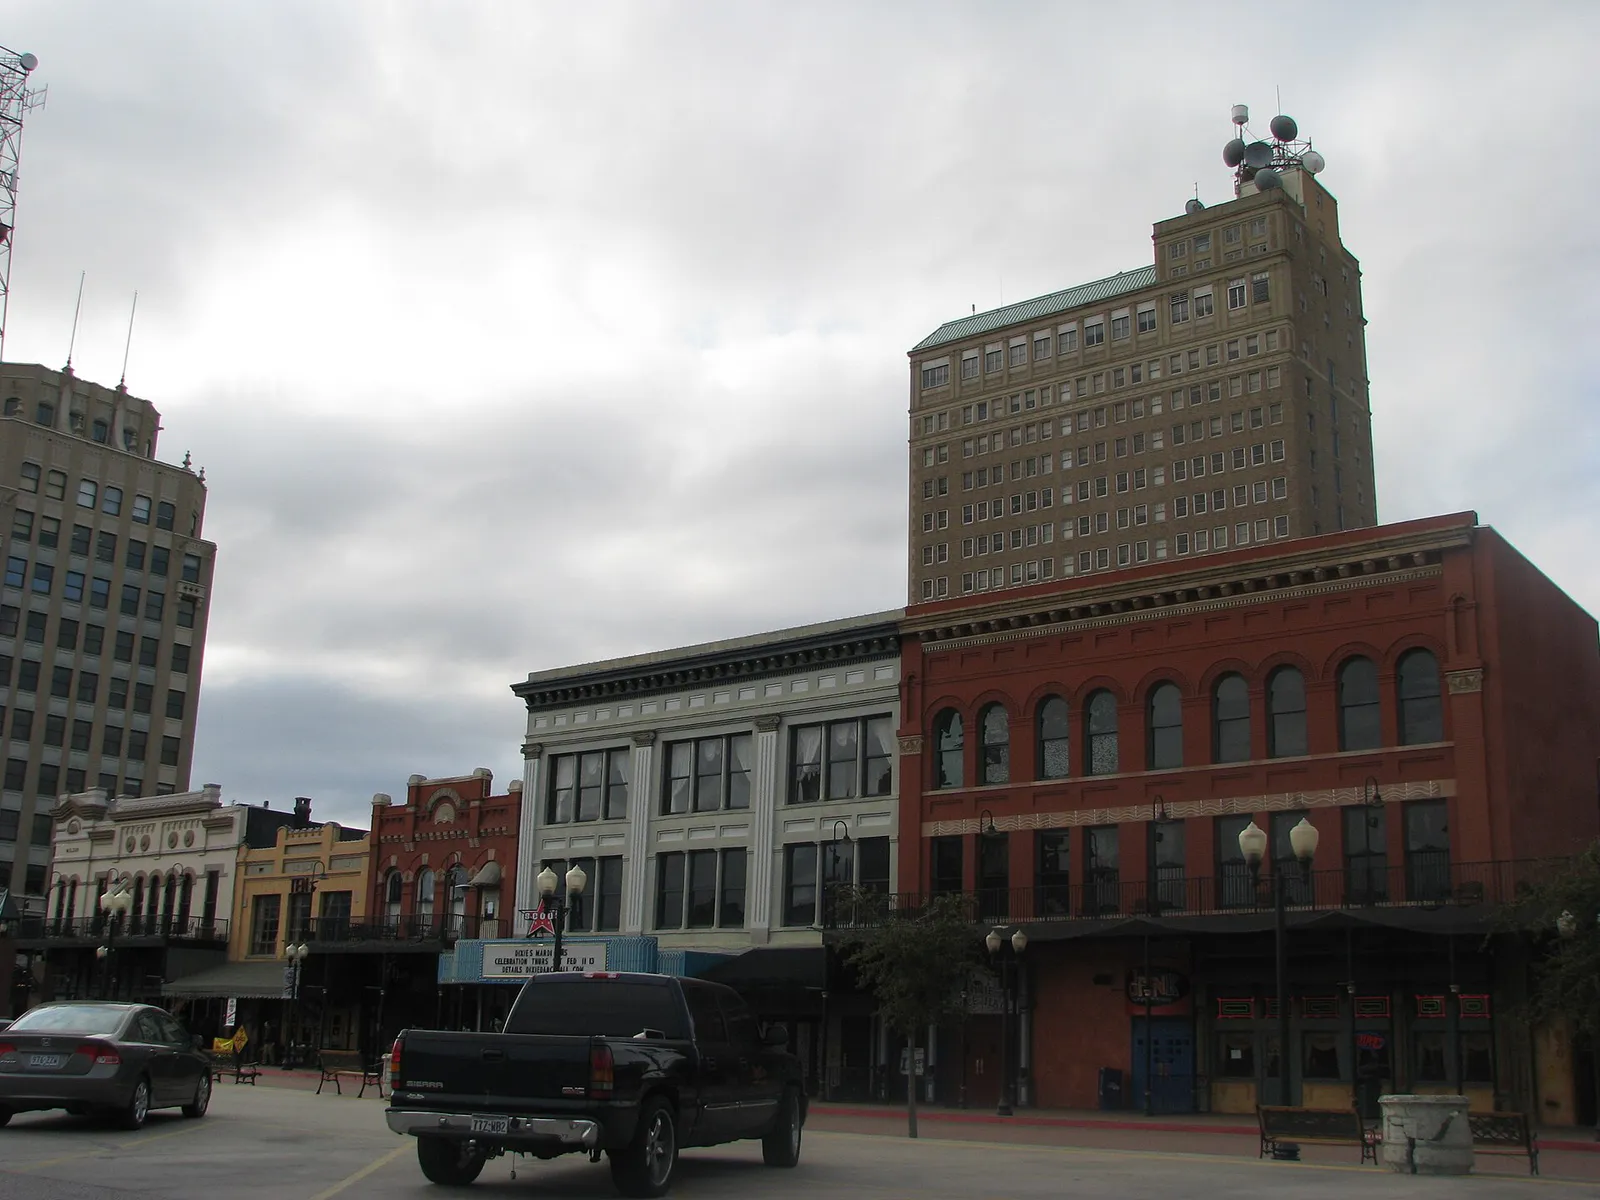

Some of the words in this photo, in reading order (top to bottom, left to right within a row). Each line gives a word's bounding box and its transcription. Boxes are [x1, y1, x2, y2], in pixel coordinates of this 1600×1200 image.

[535, 949, 553, 957] MARDI
[494, 957, 528, 965] CELEBRATION
[532, 957, 549, 965] THURS
[502, 966, 523, 974] DETAILS
[406, 1080, 444, 1089] SIERRA
